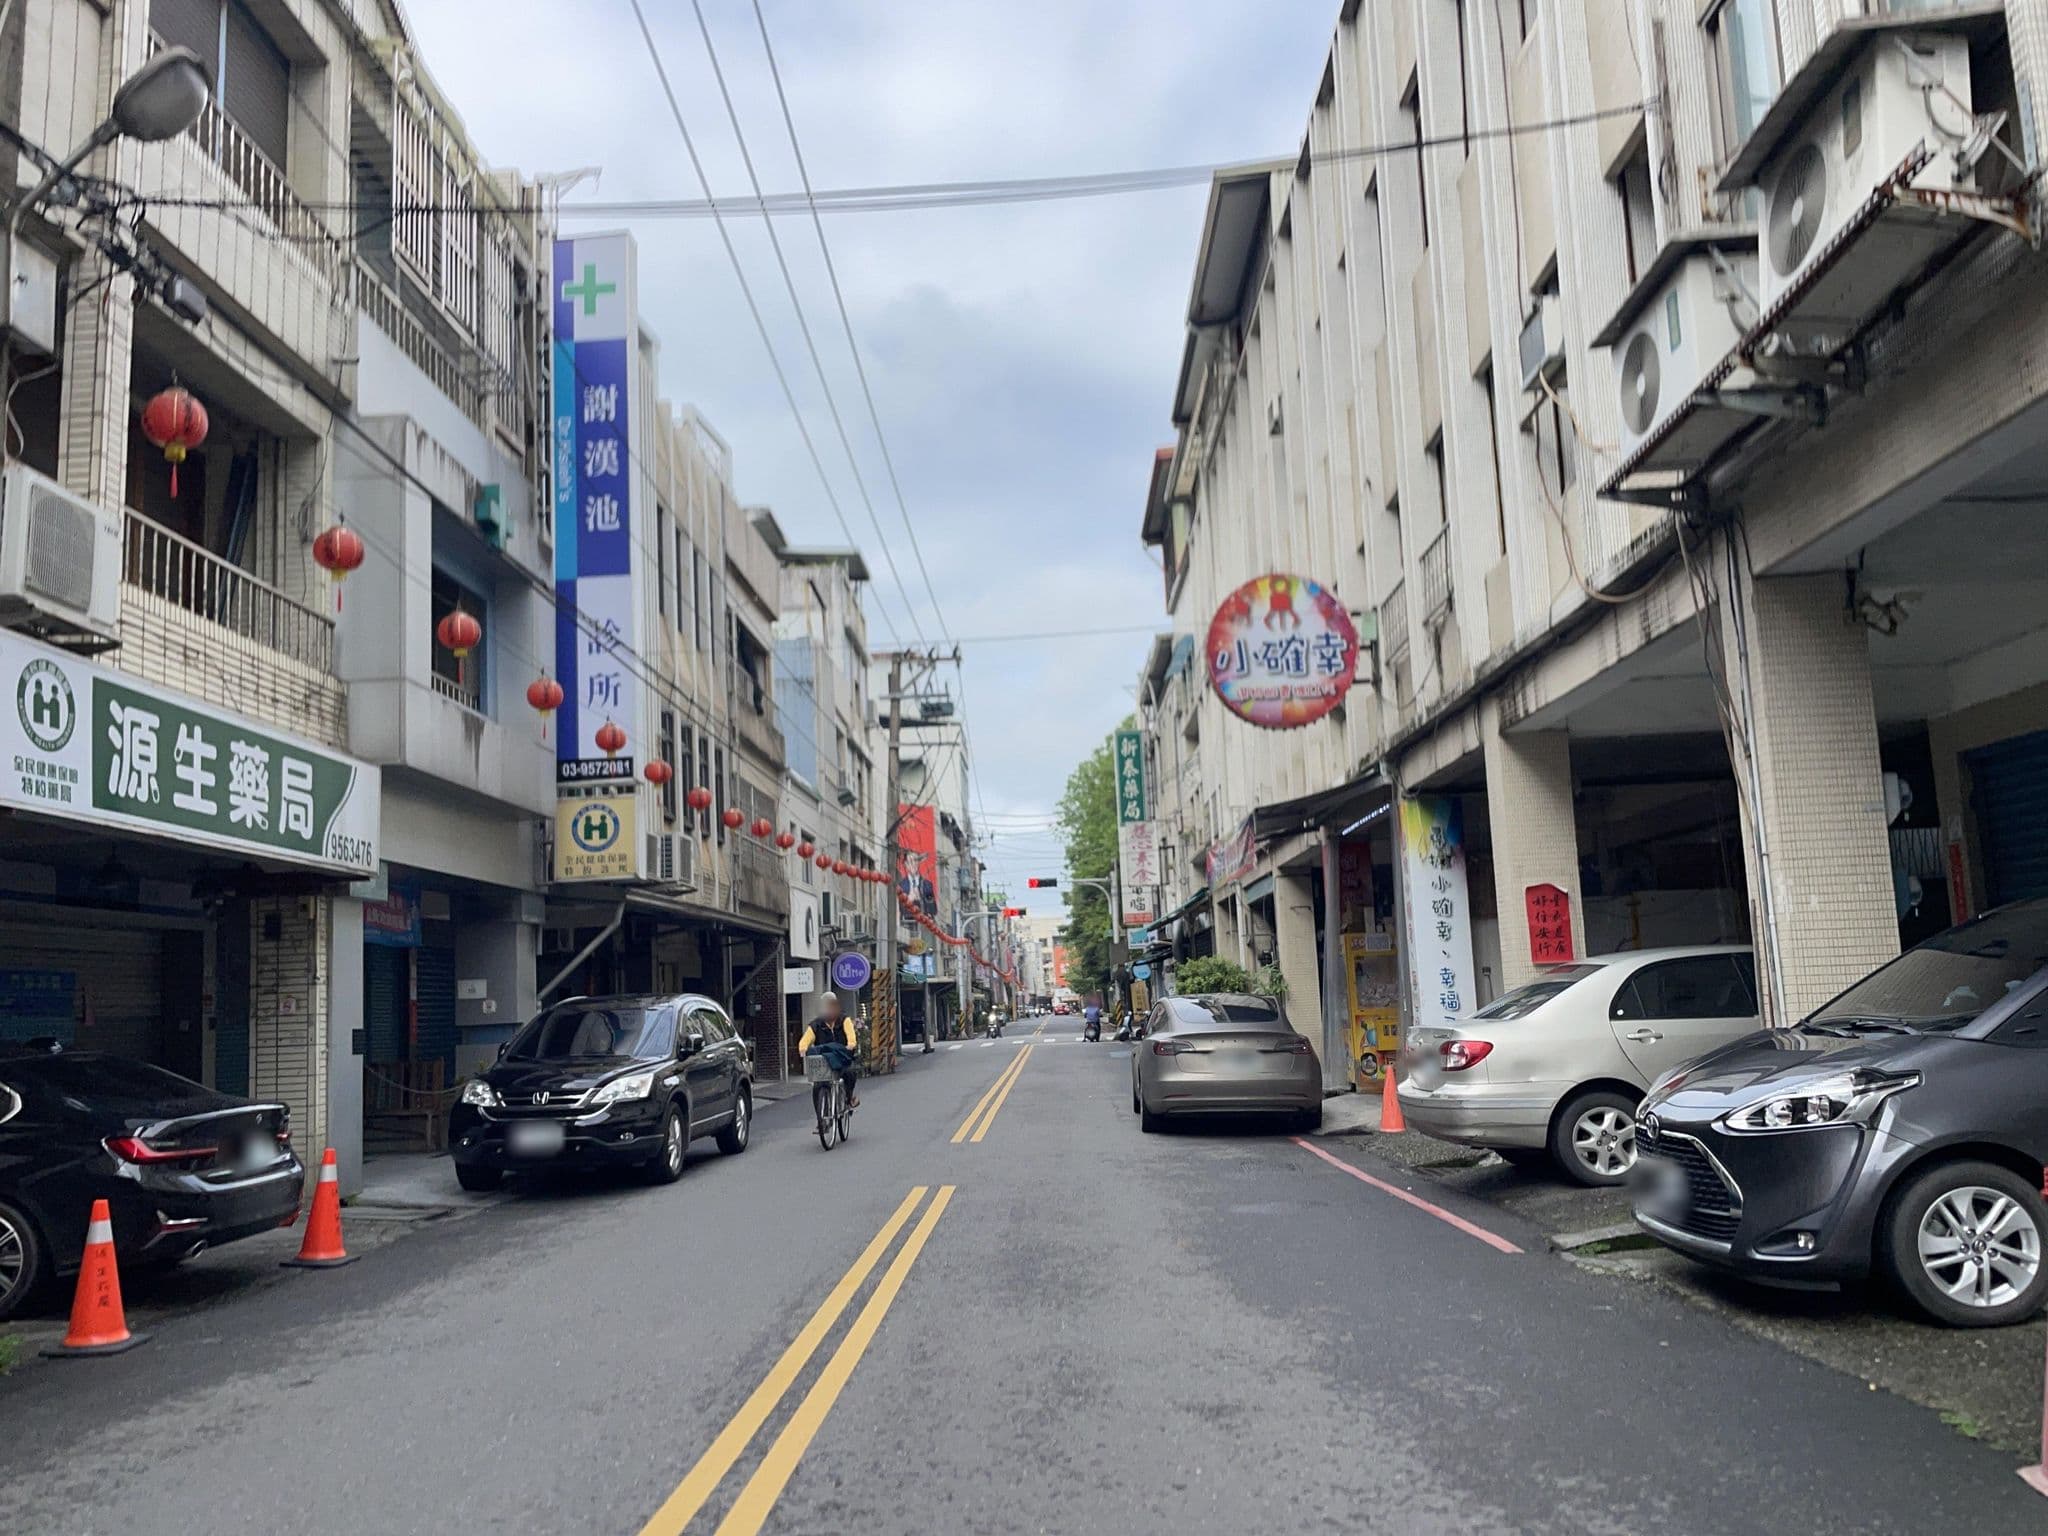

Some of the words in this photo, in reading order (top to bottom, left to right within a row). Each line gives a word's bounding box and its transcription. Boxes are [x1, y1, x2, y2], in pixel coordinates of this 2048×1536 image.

[584, 384, 620, 533] 謝漢池
[1216, 630, 1348, 677] 小確幸
[108, 699, 314, 841] 源生藥局
[562, 760, 632, 778] 03-9572081
[331, 833, 372, 867] 9563476
